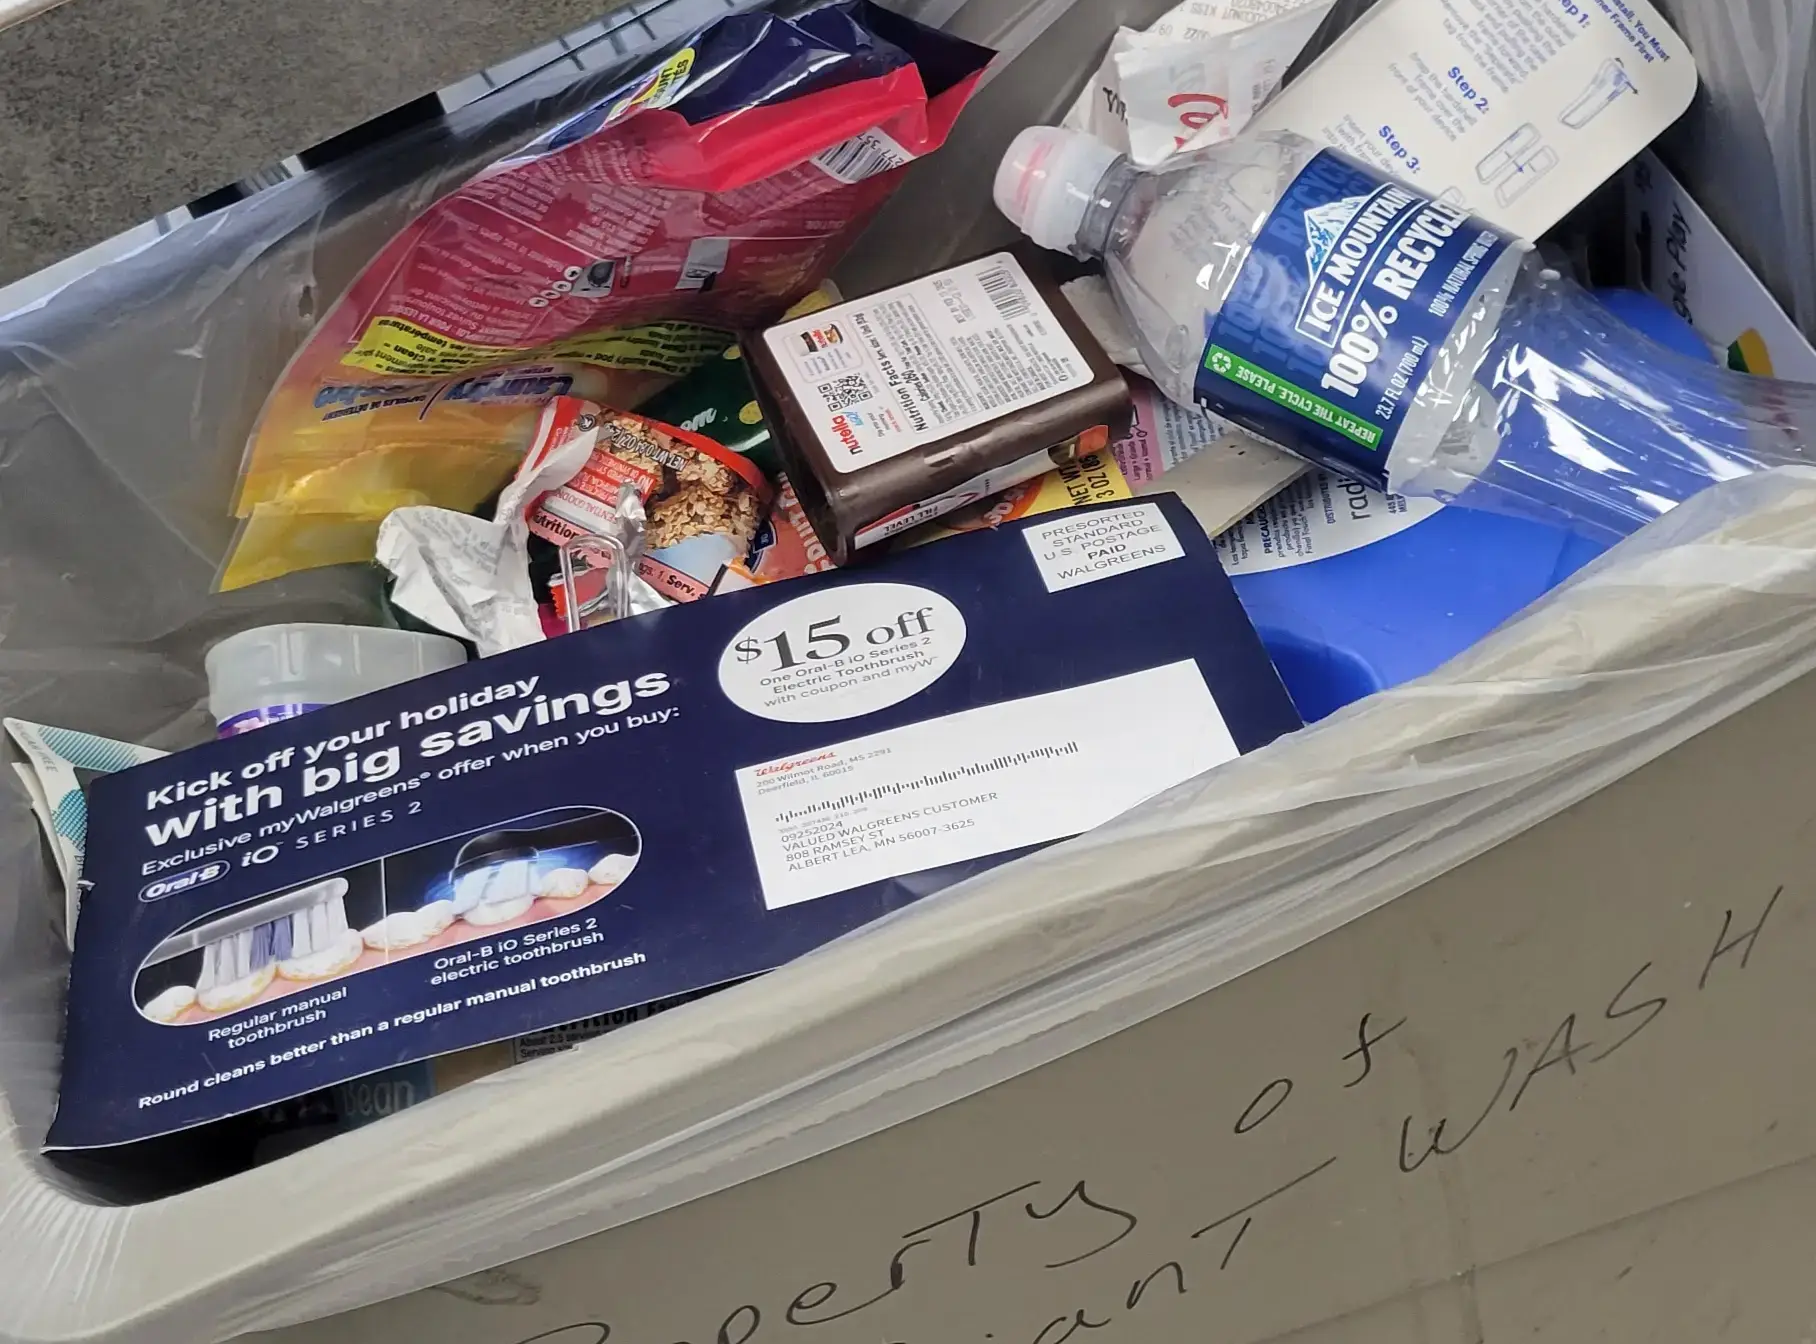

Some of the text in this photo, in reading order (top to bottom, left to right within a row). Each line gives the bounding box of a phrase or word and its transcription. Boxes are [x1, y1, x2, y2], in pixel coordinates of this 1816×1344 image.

[1578, 13, 1589, 29] 1:
[1609, 12, 1639, 44] Frame
[1633, 39, 1656, 64] First
[1632, 19, 1653, 41] You
[1646, 36, 1673, 64] Must
[1448, 66, 1489, 114] Step 2:
[881, 148, 905, 167] 277
[1379, 125, 1420, 174] Step 3:
[1304, 281, 1344, 333] ICE
[1325, 186, 1415, 287] MOUNTAIN
[1320, 201, 1471, 399] 100% RECYCLE
[1427, 287, 1453, 317] 100%
[1444, 261, 1475, 296] NATURAL
[879, 359, 902, 388] Facts
[901, 367, 931, 403] Calories 260
[1233, 365, 1278, 395] PLEASE
[1375, 334, 1430, 421] 23.7 FL OZ (700 mL)
[897, 387, 930, 432] Nutrition
[1311, 403, 1337, 424] THE
[1333, 415, 1377, 444] REPEAT
[652, 446, 670, 464] WT
[831, 414, 864, 455] nutella
[663, 452, 688, 473] NET
[1087, 470, 1112, 491] OZ
[1067, 485, 1094, 508] NET
[1096, 489, 1114, 499] 3
[1336, 478, 1376, 522] radi
[1042, 510, 1145, 540] PRESORTED
[1053, 519, 1143, 547] STANDARD
[1081, 525, 1157, 551] POSTAGE
[1057, 544, 1166, 579] WALGREENS
[1087, 544, 1126, 560] PAID
[735, 607, 933, 671] $15 off
[760, 674, 791, 686] One
[795, 659, 845, 677] Oral-B
[869, 642, 918, 659] Series
[921, 636, 932, 646] 2
[773, 651, 925, 694] Electric Toothbrush
[764, 693, 796, 707] with
[800, 678, 858, 698] coupon
[862, 668, 891, 682] and
[147, 786, 282, 845] with
[304, 747, 400, 796] big
[419, 671, 672, 757] savings
[148, 676, 545, 810] Kick off your holiday
[755, 752, 836, 777] Walgreens
[776, 768, 815, 782] Wilmot
[850, 754, 866, 763] MS
[142, 832, 252, 876] Exclusive
[438, 756, 493, 780] offer
[502, 736, 569, 761] when
[576, 722, 620, 745] you
[627, 707, 679, 729] buy:
[758, 777, 809, 796] Deerfield,
[781, 820, 844, 843] 09252024
[782, 832, 836, 852] VALUED
[838, 810, 920, 838] WALGREENS
[923, 792, 998, 816] CUSTOMER
[142, 863, 226, 900] Oral-B
[296, 810, 394, 849] SERIES
[409, 801, 422, 815] 2
[785, 828, 885, 863] 808 RAMSEY ST
[789, 818, 975, 872] ALBERT LEA, MN 56007-3625
[431, 932, 604, 985] electric toothbrush
[434, 917, 600, 970] Oral-B iO Series 2
[139, 953, 646, 1109] Round cleans better than a regular manual toothbrush
[208, 987, 347, 1041] Regular manual
[223, 1010, 326, 1048] toothbrush
[1396, 884, 1785, 1174] WASH
[1235, 1013, 1406, 1134] of
